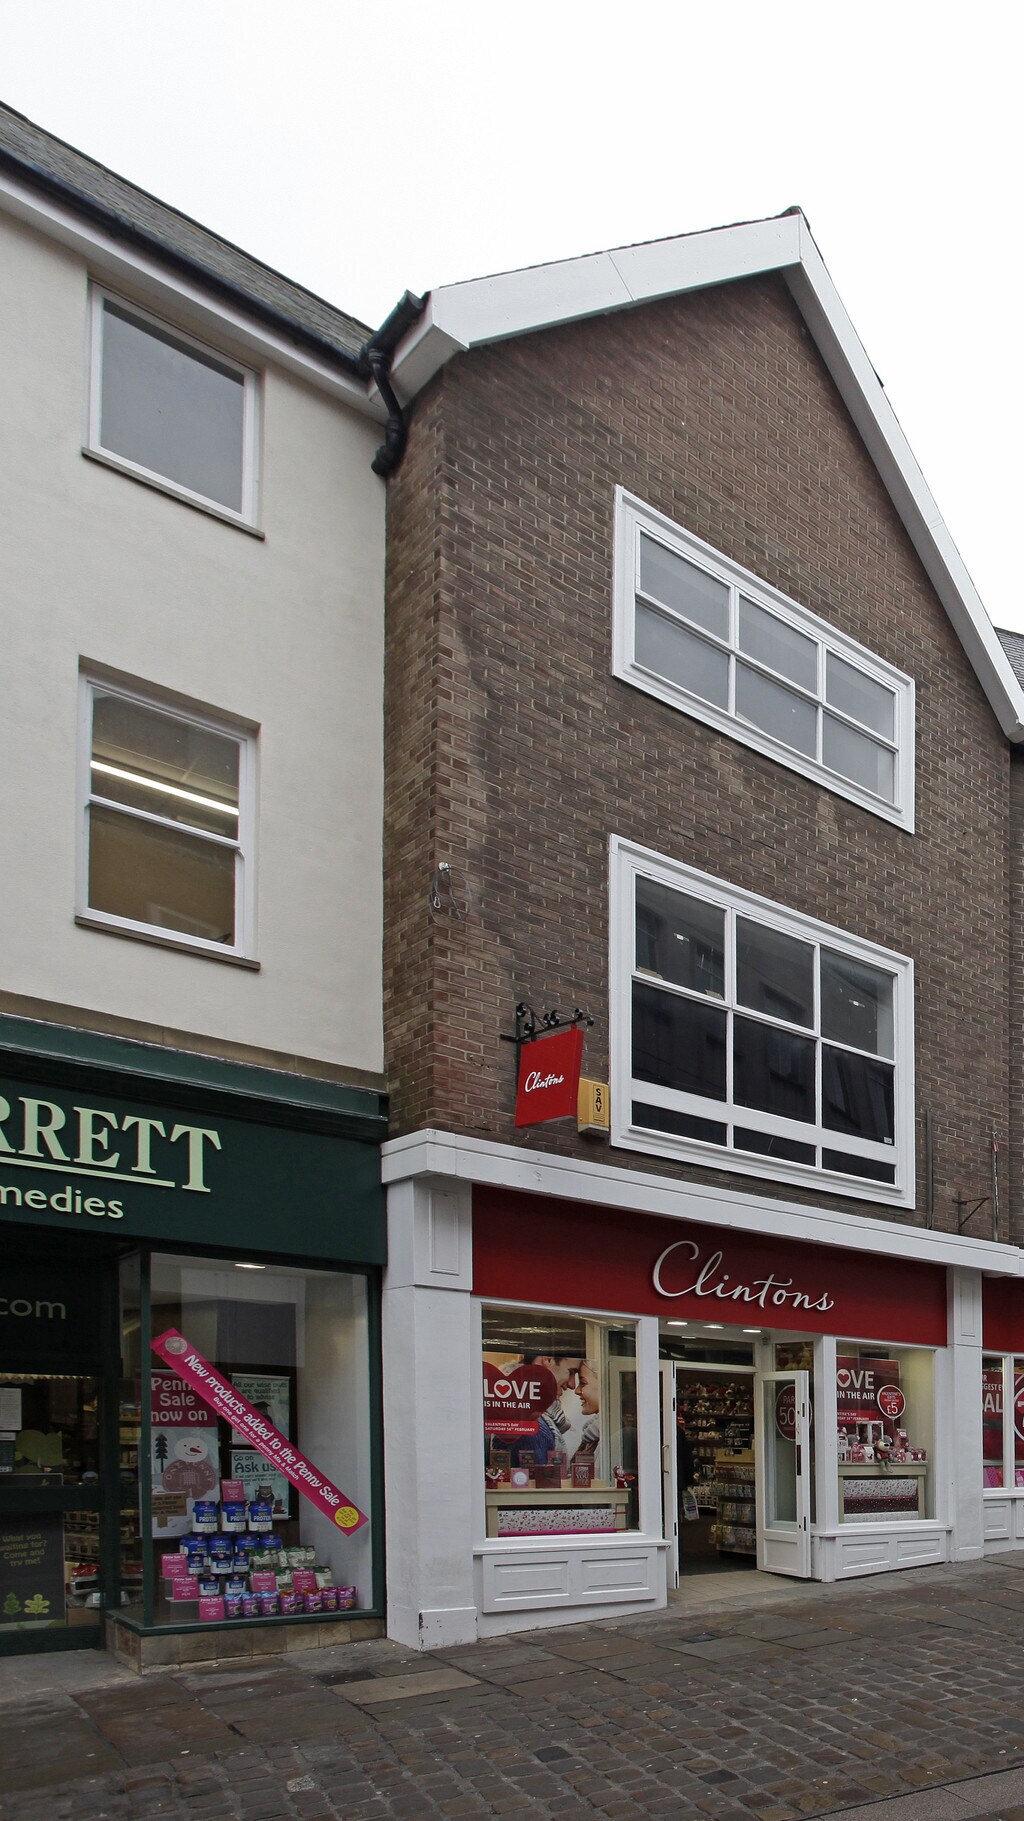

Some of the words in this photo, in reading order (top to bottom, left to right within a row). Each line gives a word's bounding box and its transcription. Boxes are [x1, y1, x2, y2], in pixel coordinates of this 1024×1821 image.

[525, 1071, 565, 1093] Clintons
[595, 1088, 603, 1112] SAV
[652, 1240, 835, 1311] Clintons
[151, 1377, 196, 1391] Penn
[837, 1368, 875, 1390] OVE
[982, 1383, 998, 1391] GEST
[483, 1378, 541, 1400] LOVE
[846, 1391, 861, 1400] THE
[862, 1392, 876, 1401] AIR
[160, 1393, 195, 1407] Sale
[886, 1402, 898, 1414] £5
[151, 1410, 183, 1422] now
[188, 1410, 208, 1421] on
[184, 1354, 209, 1377] New
[205, 1377, 246, 1415] products
[243, 1413, 274, 1440] added
[269, 1438, 282, 1450] to
[279, 1447, 297, 1464] the
[293, 1461, 323, 1488] Penny
[319, 1486, 340, 1506] Sale
[213, 1396, 223, 1407] Buy
[222, 1406, 233, 1416] one
[285, 1466, 299, 1481] Match
[234, 1461, 259, 1474] Ask
